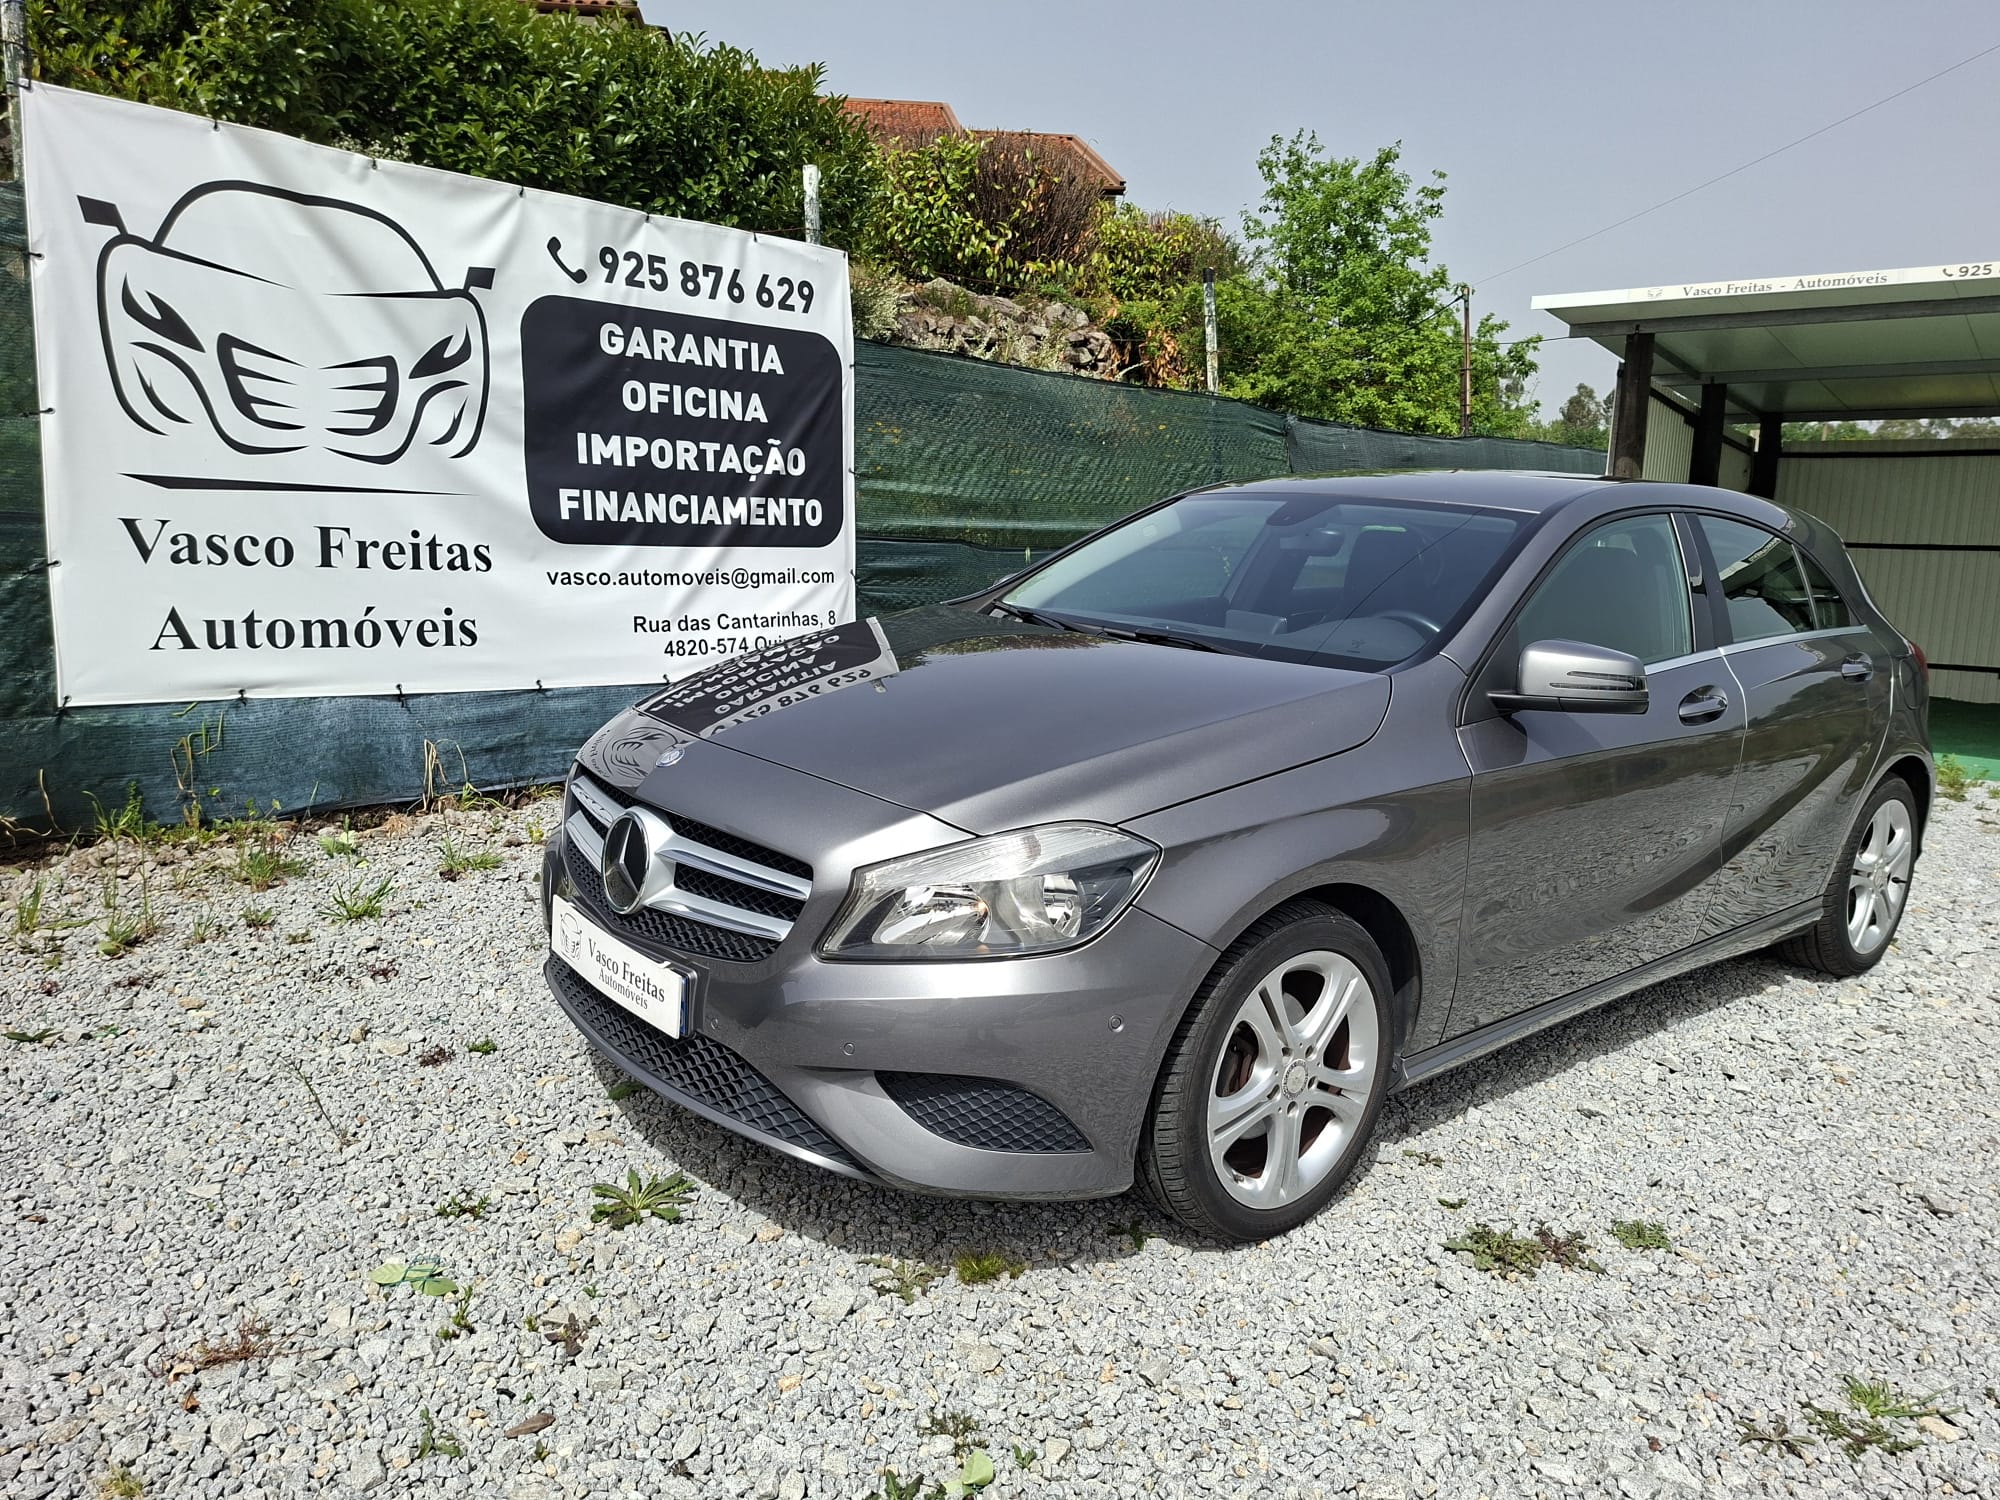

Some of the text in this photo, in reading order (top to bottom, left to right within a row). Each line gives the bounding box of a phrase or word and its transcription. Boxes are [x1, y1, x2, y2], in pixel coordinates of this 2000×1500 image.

[599, 246, 815, 314] 925 876 629
[1683, 286, 1722, 297] Vasco
[1726, 282, 1773, 294] Freitas
[1793, 272, 1888, 289] Automóveis
[1958, 264, 1993, 277] 925
[600, 322, 784, 375] GARANTIA
[622, 380, 768, 423] OFICINA
[577, 432, 806, 481] IMPORTAÇÃO
[559, 488, 823, 527] FINANCIAMENTO
[117, 516, 493, 572] Vasco Freitas
[546, 567, 835, 589] vasco.automoveis@gmail.com
[148, 604, 479, 650] Automóveis
[633, 610, 837, 633] Rua das Cantarinhas, 8
[664, 637, 748, 657] 4820-574
[588, 938, 665, 1003] Vasco Freitas
[598, 967, 648, 1010] Automóveis
